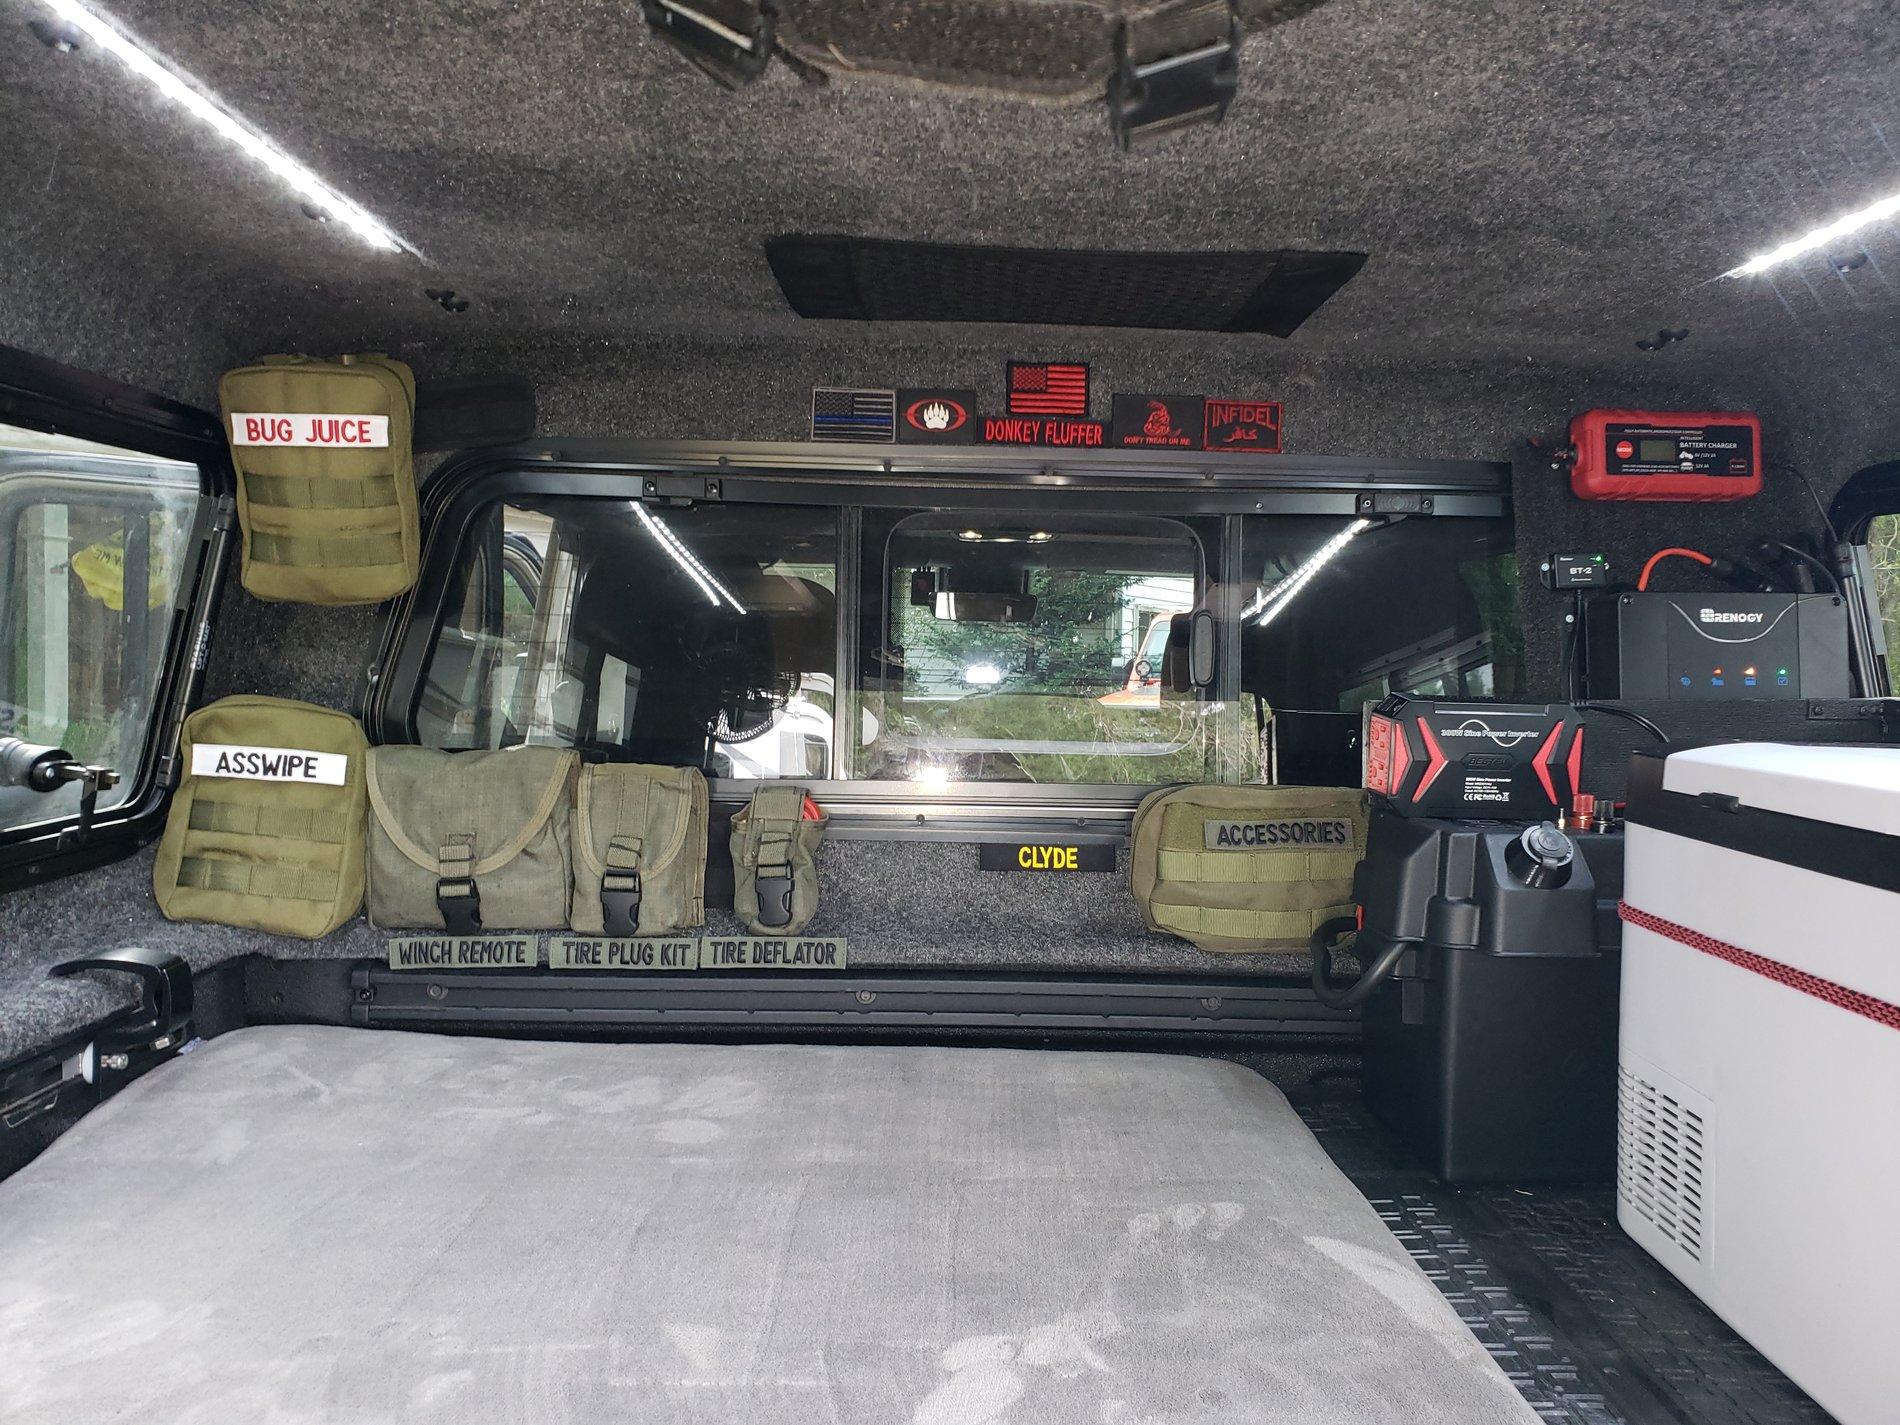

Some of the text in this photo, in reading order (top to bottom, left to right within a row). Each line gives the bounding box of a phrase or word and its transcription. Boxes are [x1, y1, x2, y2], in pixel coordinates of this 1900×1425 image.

[1211, 405, 1277, 431] INFIDEL
[246, 418, 372, 443] BUG JUICE
[985, 418, 1103, 446] DONKEY FLUFFER
[1145, 437, 1167, 446] TREAD
[1168, 437, 1178, 446] ON
[1680, 441, 1707, 449] BATTERY
[1569, 566, 1593, 575] BT-2
[1714, 612, 1764, 623] RENOGY
[1463, 729, 1482, 737] Sine
[1482, 729, 1508, 738] Power
[1507, 730, 1540, 738] Inverter
[215, 751, 319, 779] ASSWIPE
[1216, 823, 1346, 846] ACCESSORIES
[1018, 846, 1078, 869] CLYDE
[399, 940, 527, 965] WINCH REMOTE
[562, 941, 691, 966] TIRE PLUG KIT
[710, 941, 837, 965] TIRE DEFLATOR
